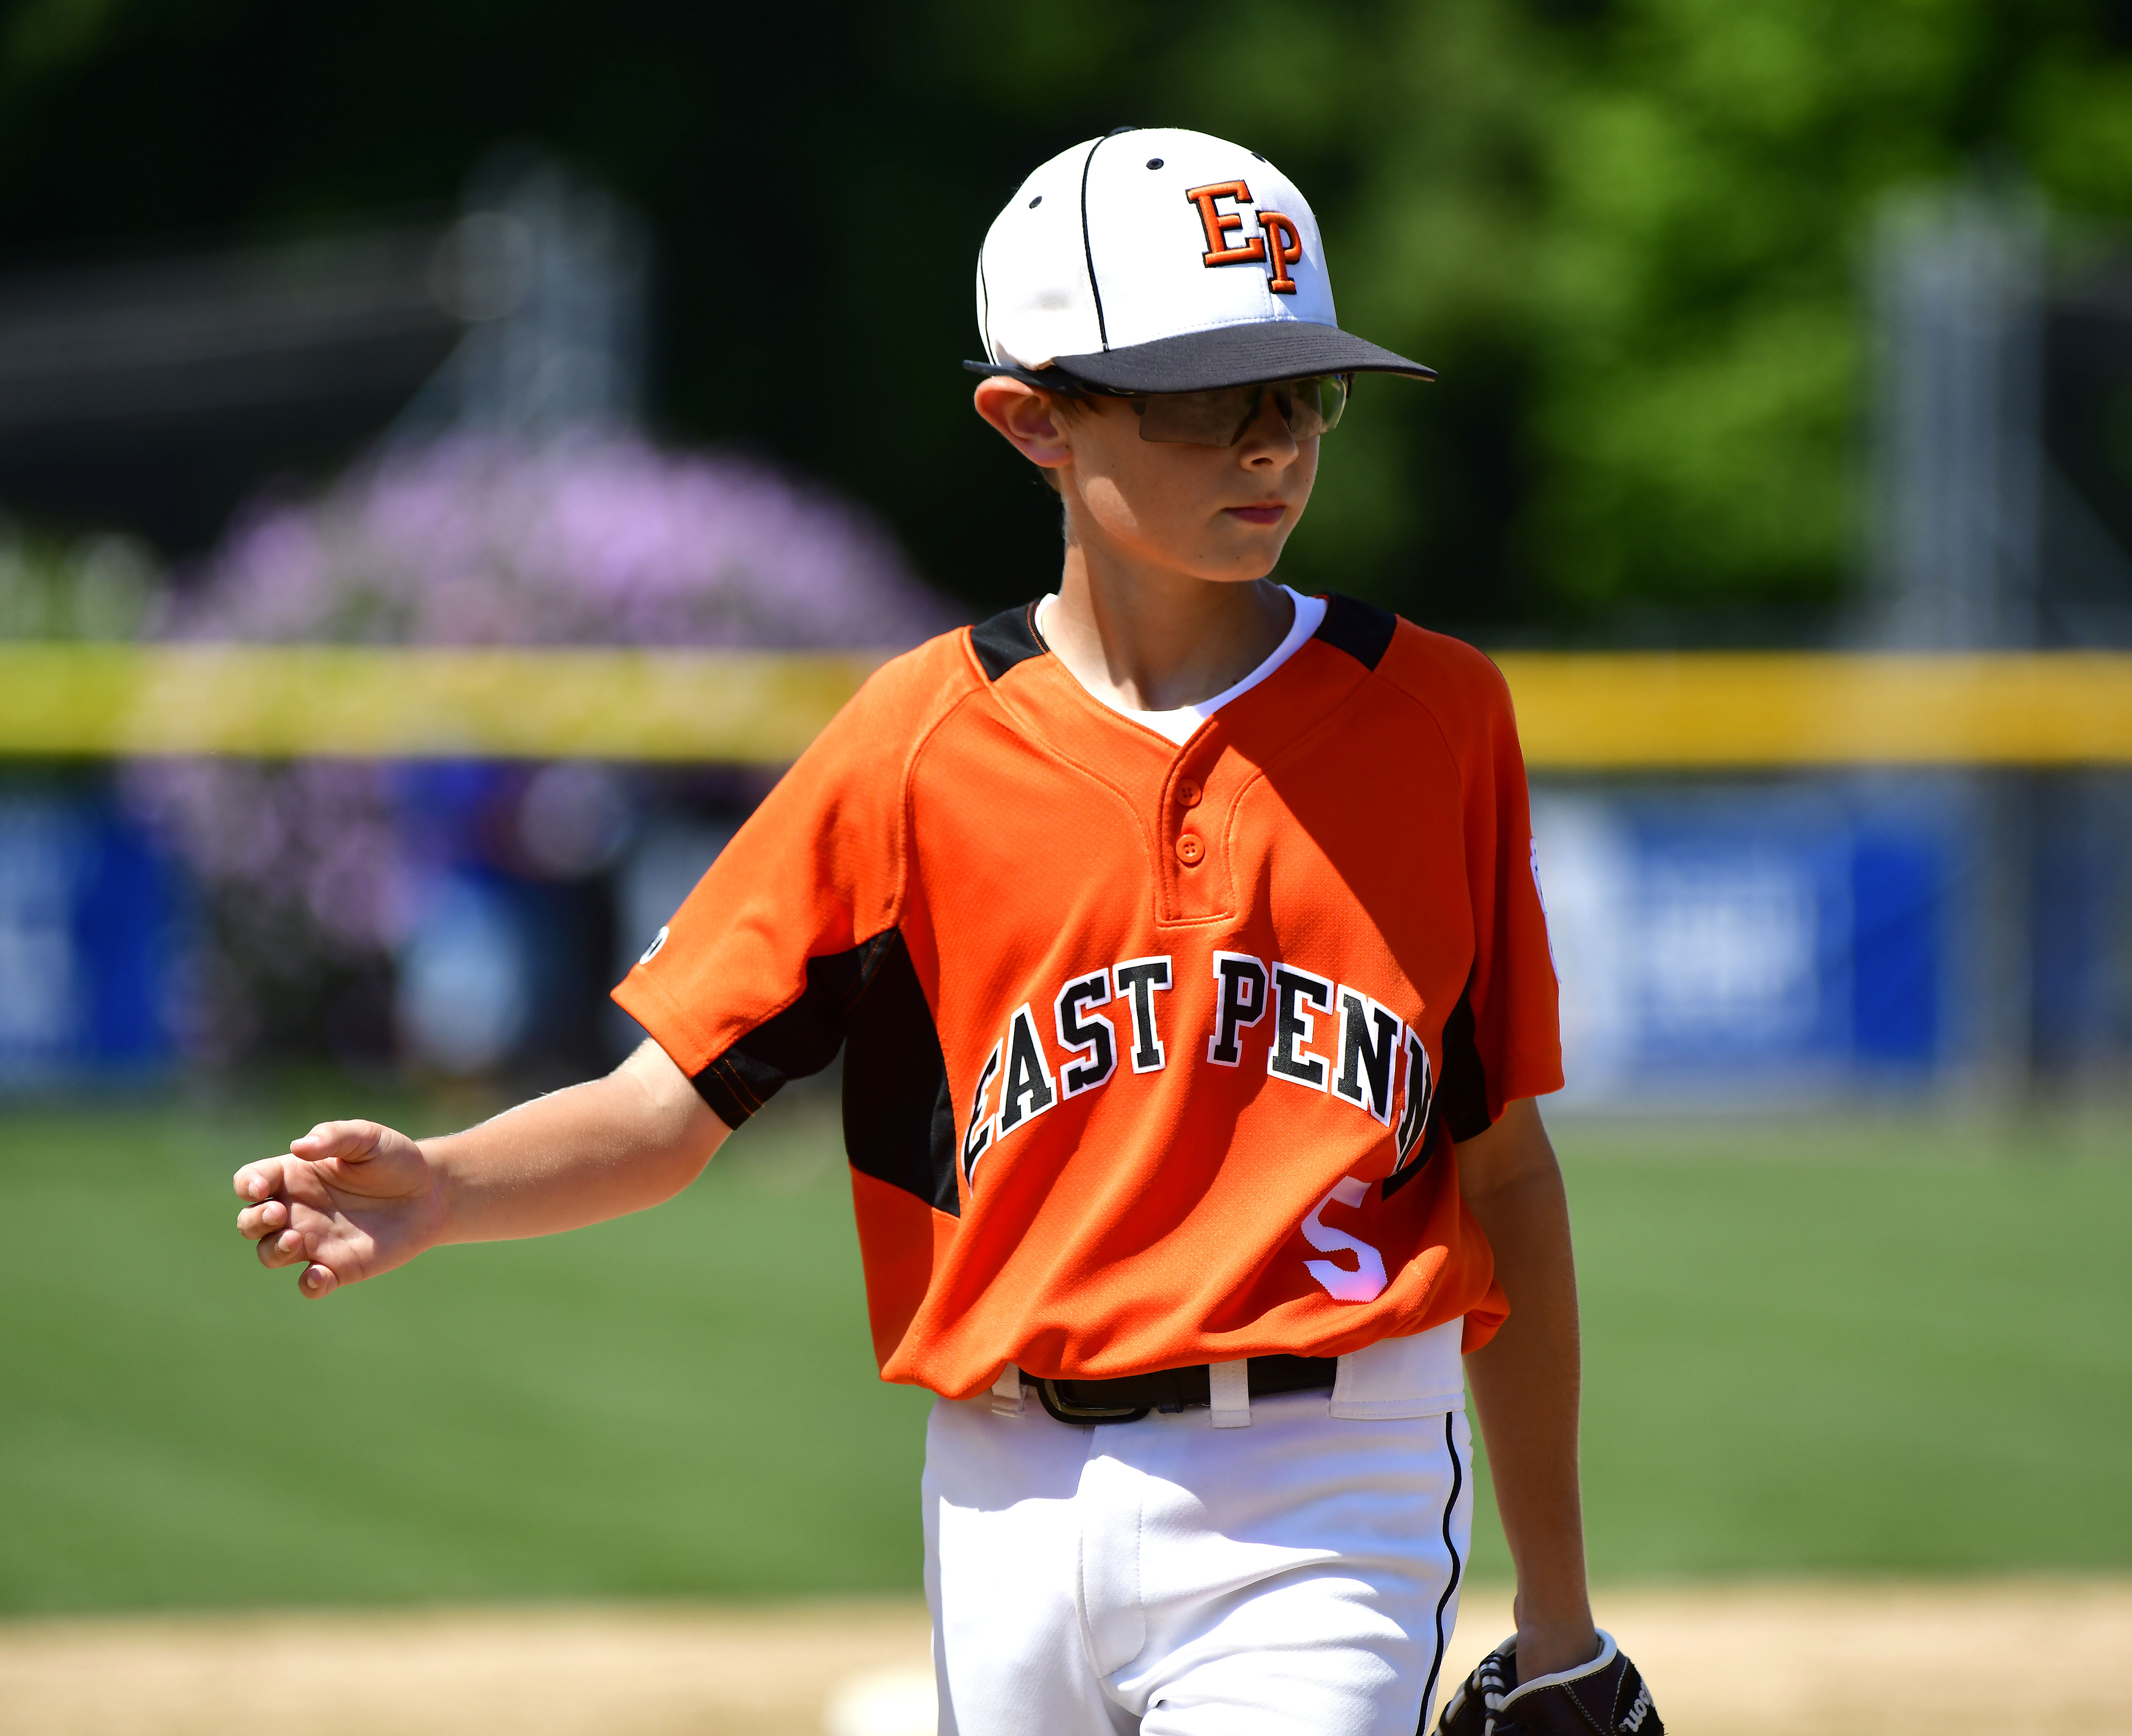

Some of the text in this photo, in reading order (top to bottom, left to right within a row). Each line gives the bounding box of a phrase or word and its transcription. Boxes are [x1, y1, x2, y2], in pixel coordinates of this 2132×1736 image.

[1185, 180, 1302, 295] EP
[961, 950, 1433, 1199] EAST PENN
